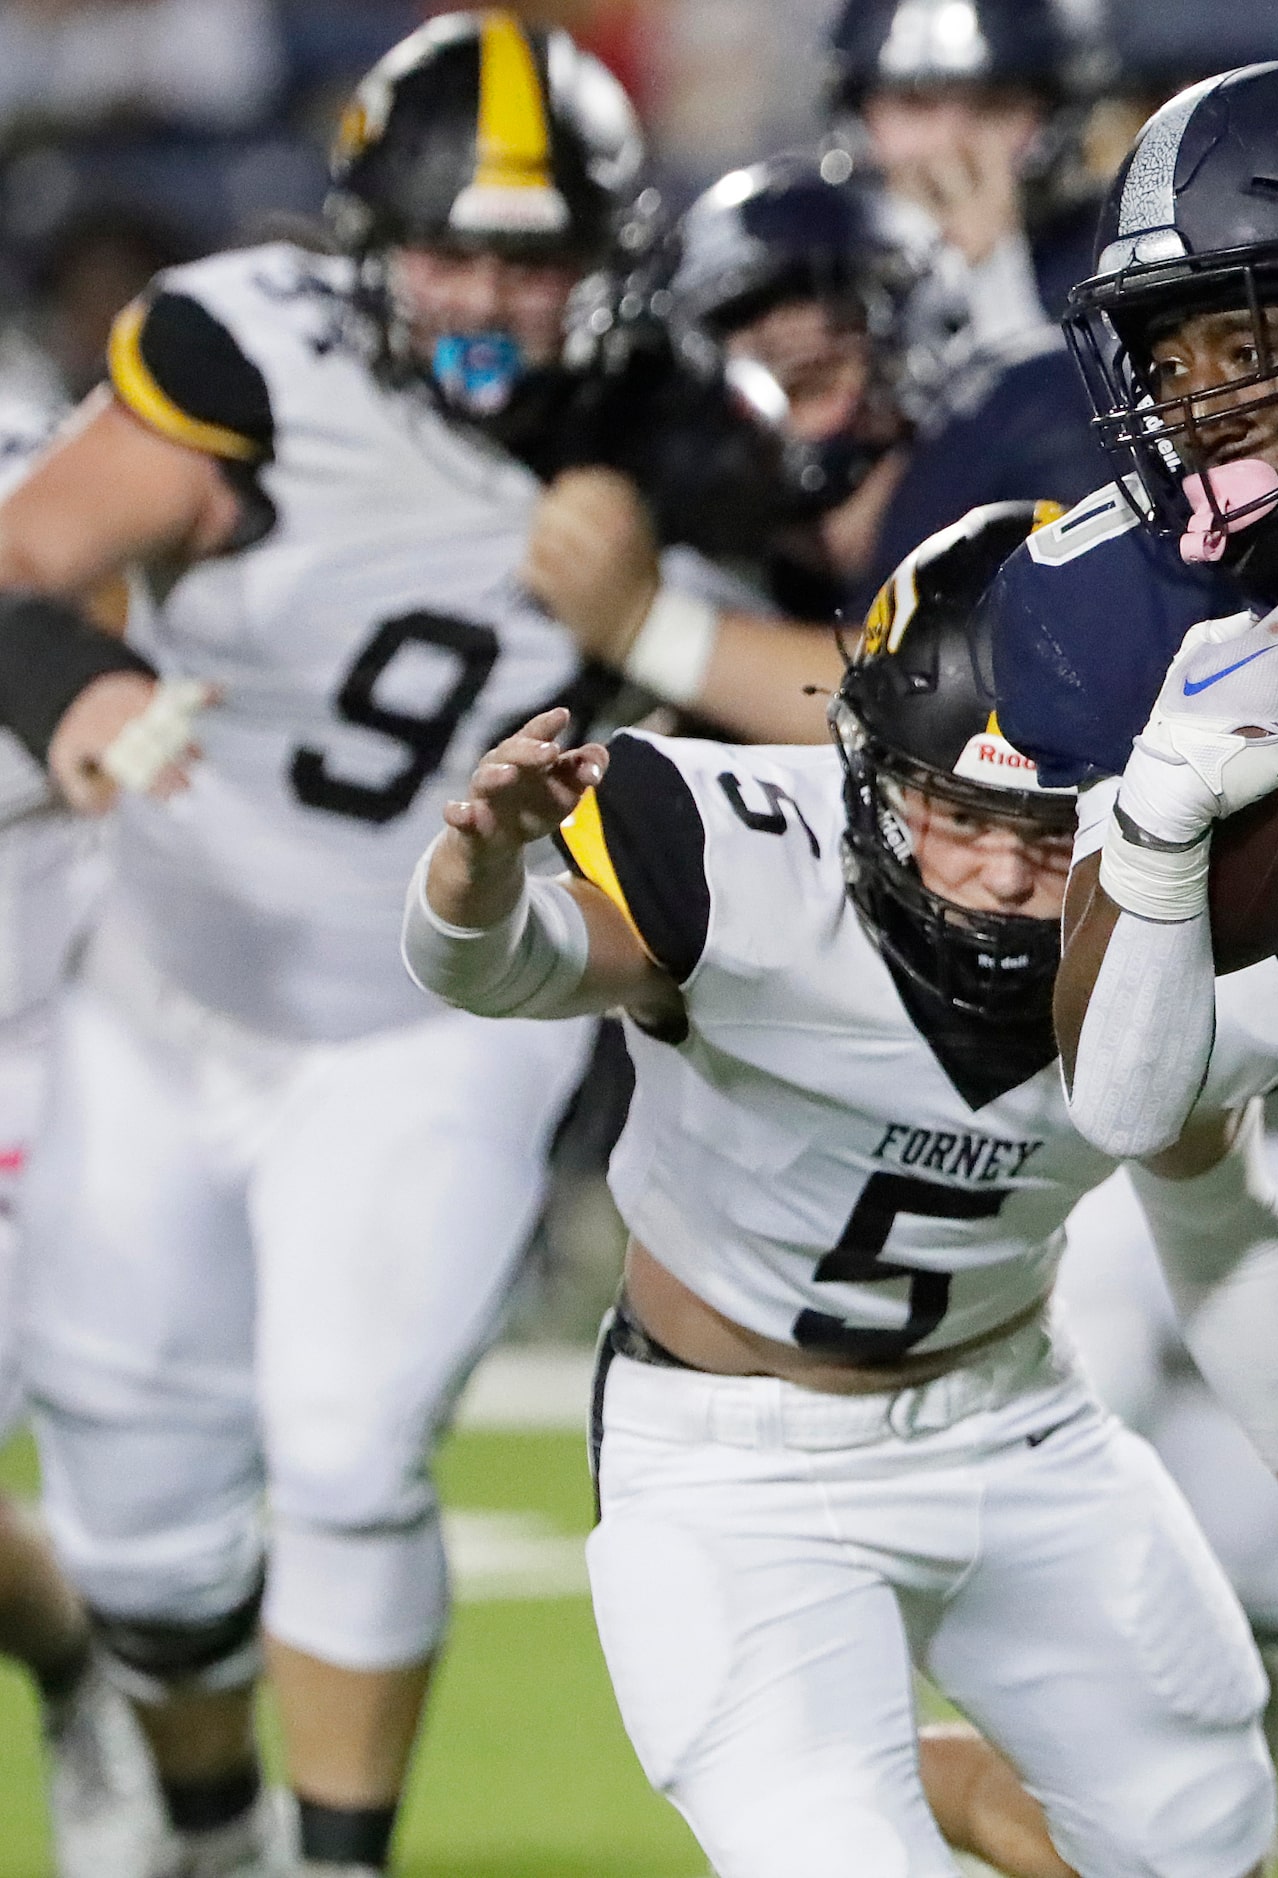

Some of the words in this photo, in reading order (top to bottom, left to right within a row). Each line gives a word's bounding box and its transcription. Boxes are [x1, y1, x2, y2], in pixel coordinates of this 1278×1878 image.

[287, 608, 626, 828] 9
[717, 771, 820, 859] 5
[870, 1122, 1045, 1181] FORNEY
[792, 1171, 1017, 1364] 5
